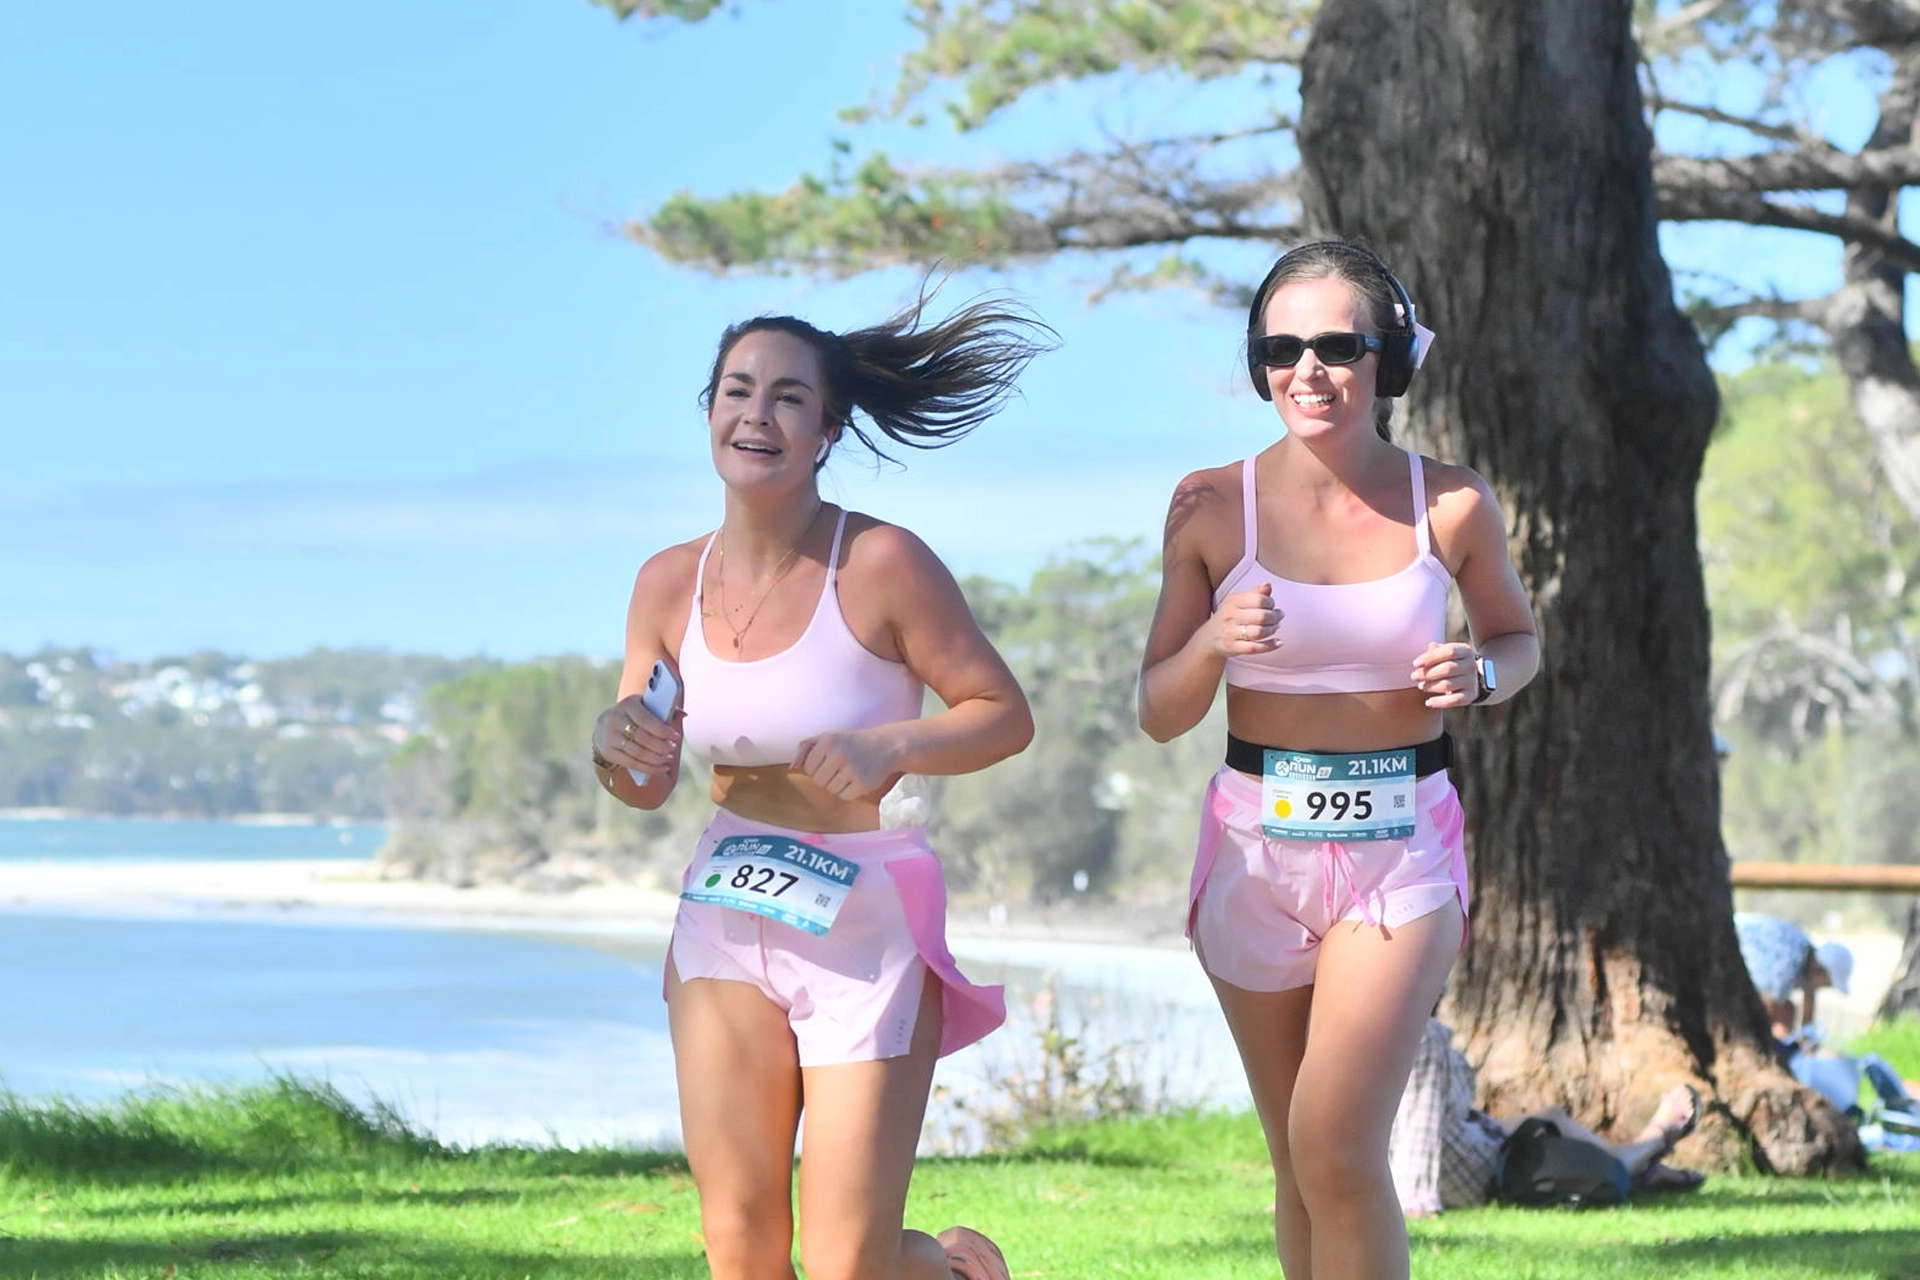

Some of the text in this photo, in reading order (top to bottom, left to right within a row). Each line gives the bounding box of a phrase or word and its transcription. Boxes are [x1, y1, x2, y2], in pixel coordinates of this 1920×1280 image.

[1289, 761, 1316, 774] RUN
[1348, 755, 1407, 776] 21.1KM
[1306, 790, 1373, 821] 995
[784, 844, 849, 881] 21.1KM
[730, 864, 800, 898] 827
